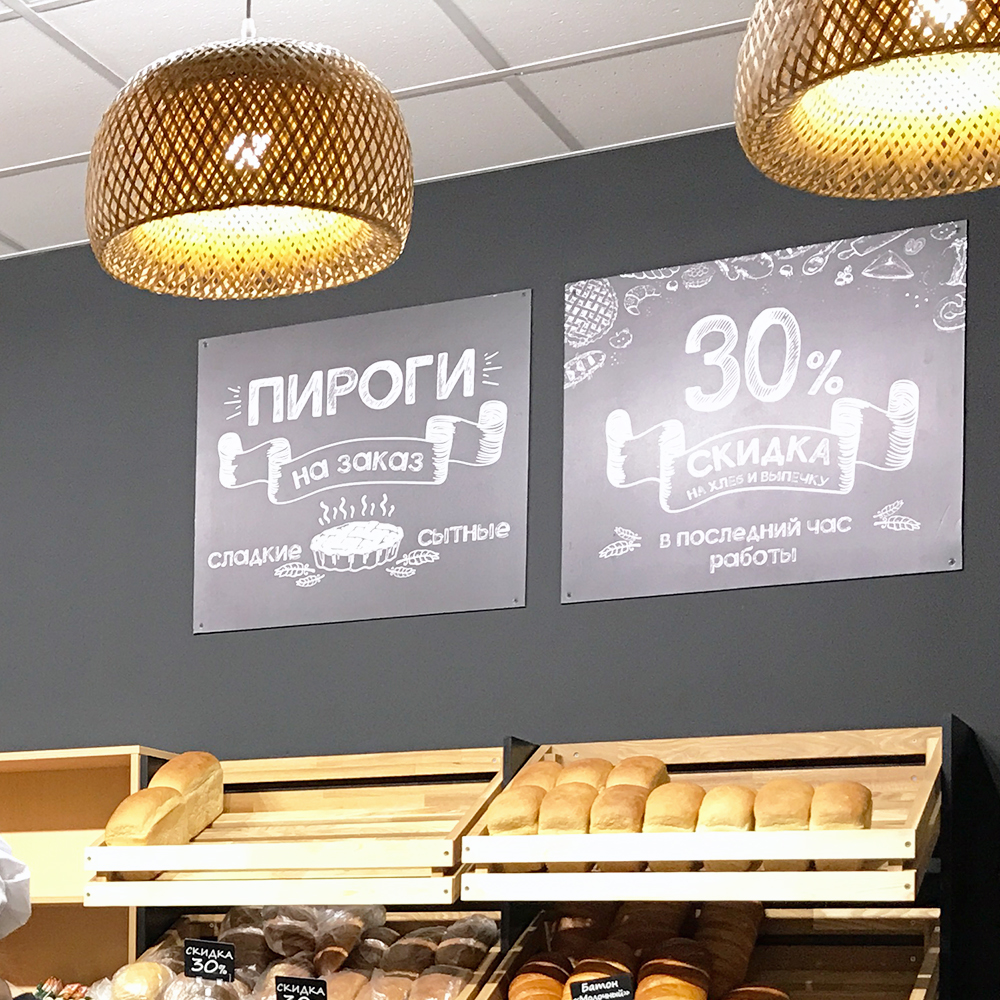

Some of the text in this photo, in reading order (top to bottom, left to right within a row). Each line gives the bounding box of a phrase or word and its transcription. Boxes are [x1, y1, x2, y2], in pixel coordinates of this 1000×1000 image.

[685, 306, 844, 412] 30%
[248, 348, 475, 426] ПИРОГИ
[291, 450, 425, 490] на заказ
[686, 435, 830, 478] СКИДКА
[686, 470, 830, 500] НА ХЛЕБ И ВЫПЕЧКУ
[417, 521, 511, 547] сытные
[677, 516, 801, 548] последний
[806, 515, 853, 535] час
[207, 542, 303, 569] сладкие
[709, 545, 797, 574] работы
[185, 946, 234, 960] СКИДКА
[191, 957, 228, 975] 30%
[276, 983, 326, 996] СКИДКА
[581, 980, 619, 993] Батон
